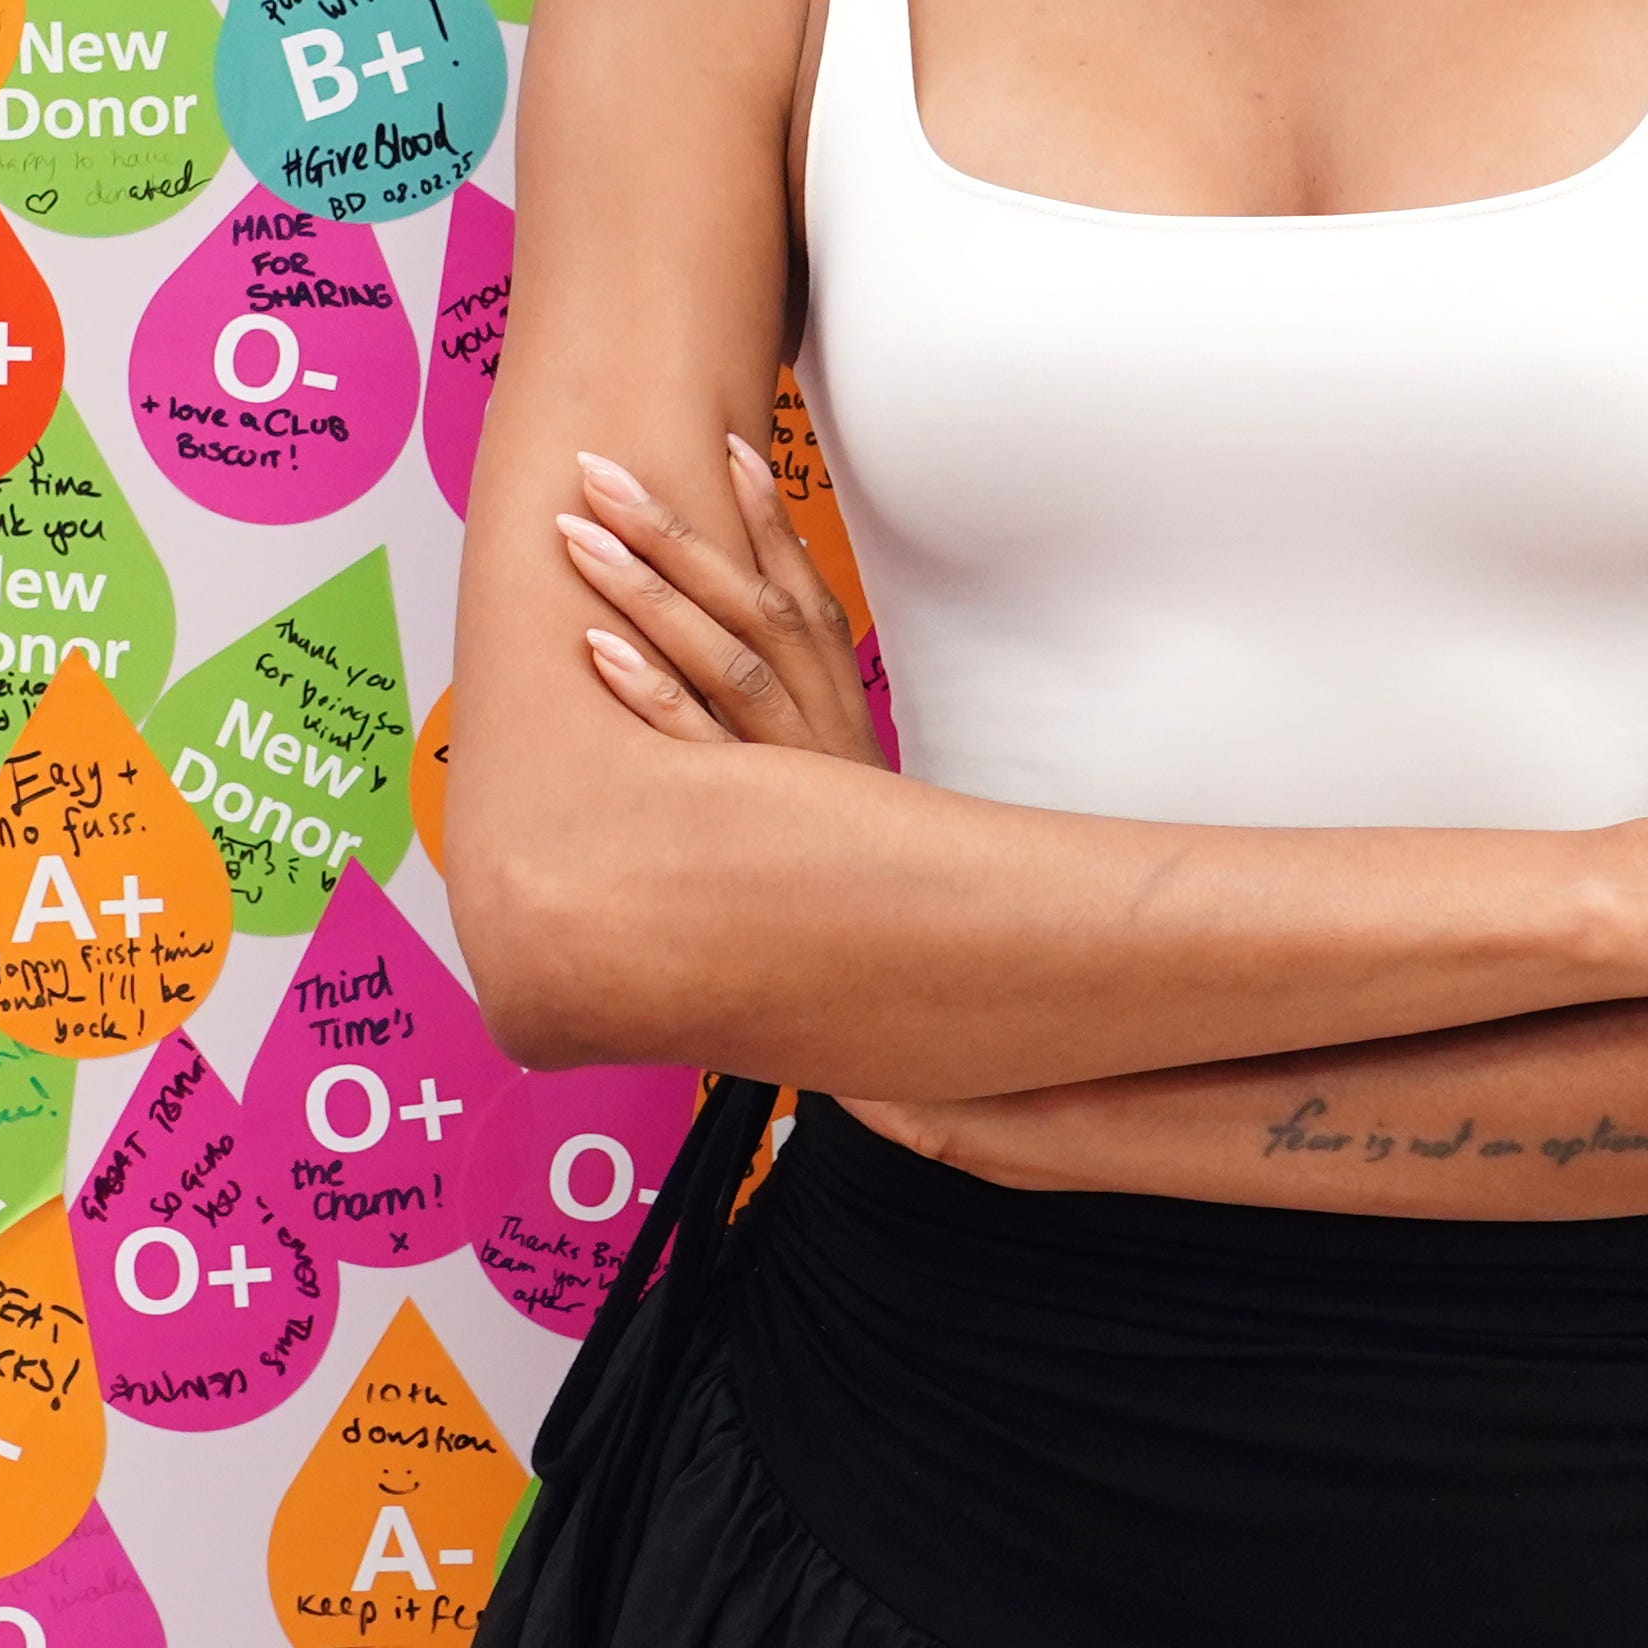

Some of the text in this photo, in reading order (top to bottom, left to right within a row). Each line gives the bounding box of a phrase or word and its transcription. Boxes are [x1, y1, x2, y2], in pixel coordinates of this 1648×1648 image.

[280, 22, 427, 124] B+
[233, 212, 317, 245] MADE
[249, 280, 393, 310] SHARING
[213, 314, 339, 405] O-
[10, 853, 165, 947] A+
[295, 959, 393, 1015] Third
[304, 1064, 464, 1155] O+
[1261, 1099, 1352, 1158] fear
[1364, 1122, 1392, 1161] is
[1410, 1120, 1474, 1157] not
[1480, 1138, 1522, 1155] an
[351, 1505, 474, 1593] A-
